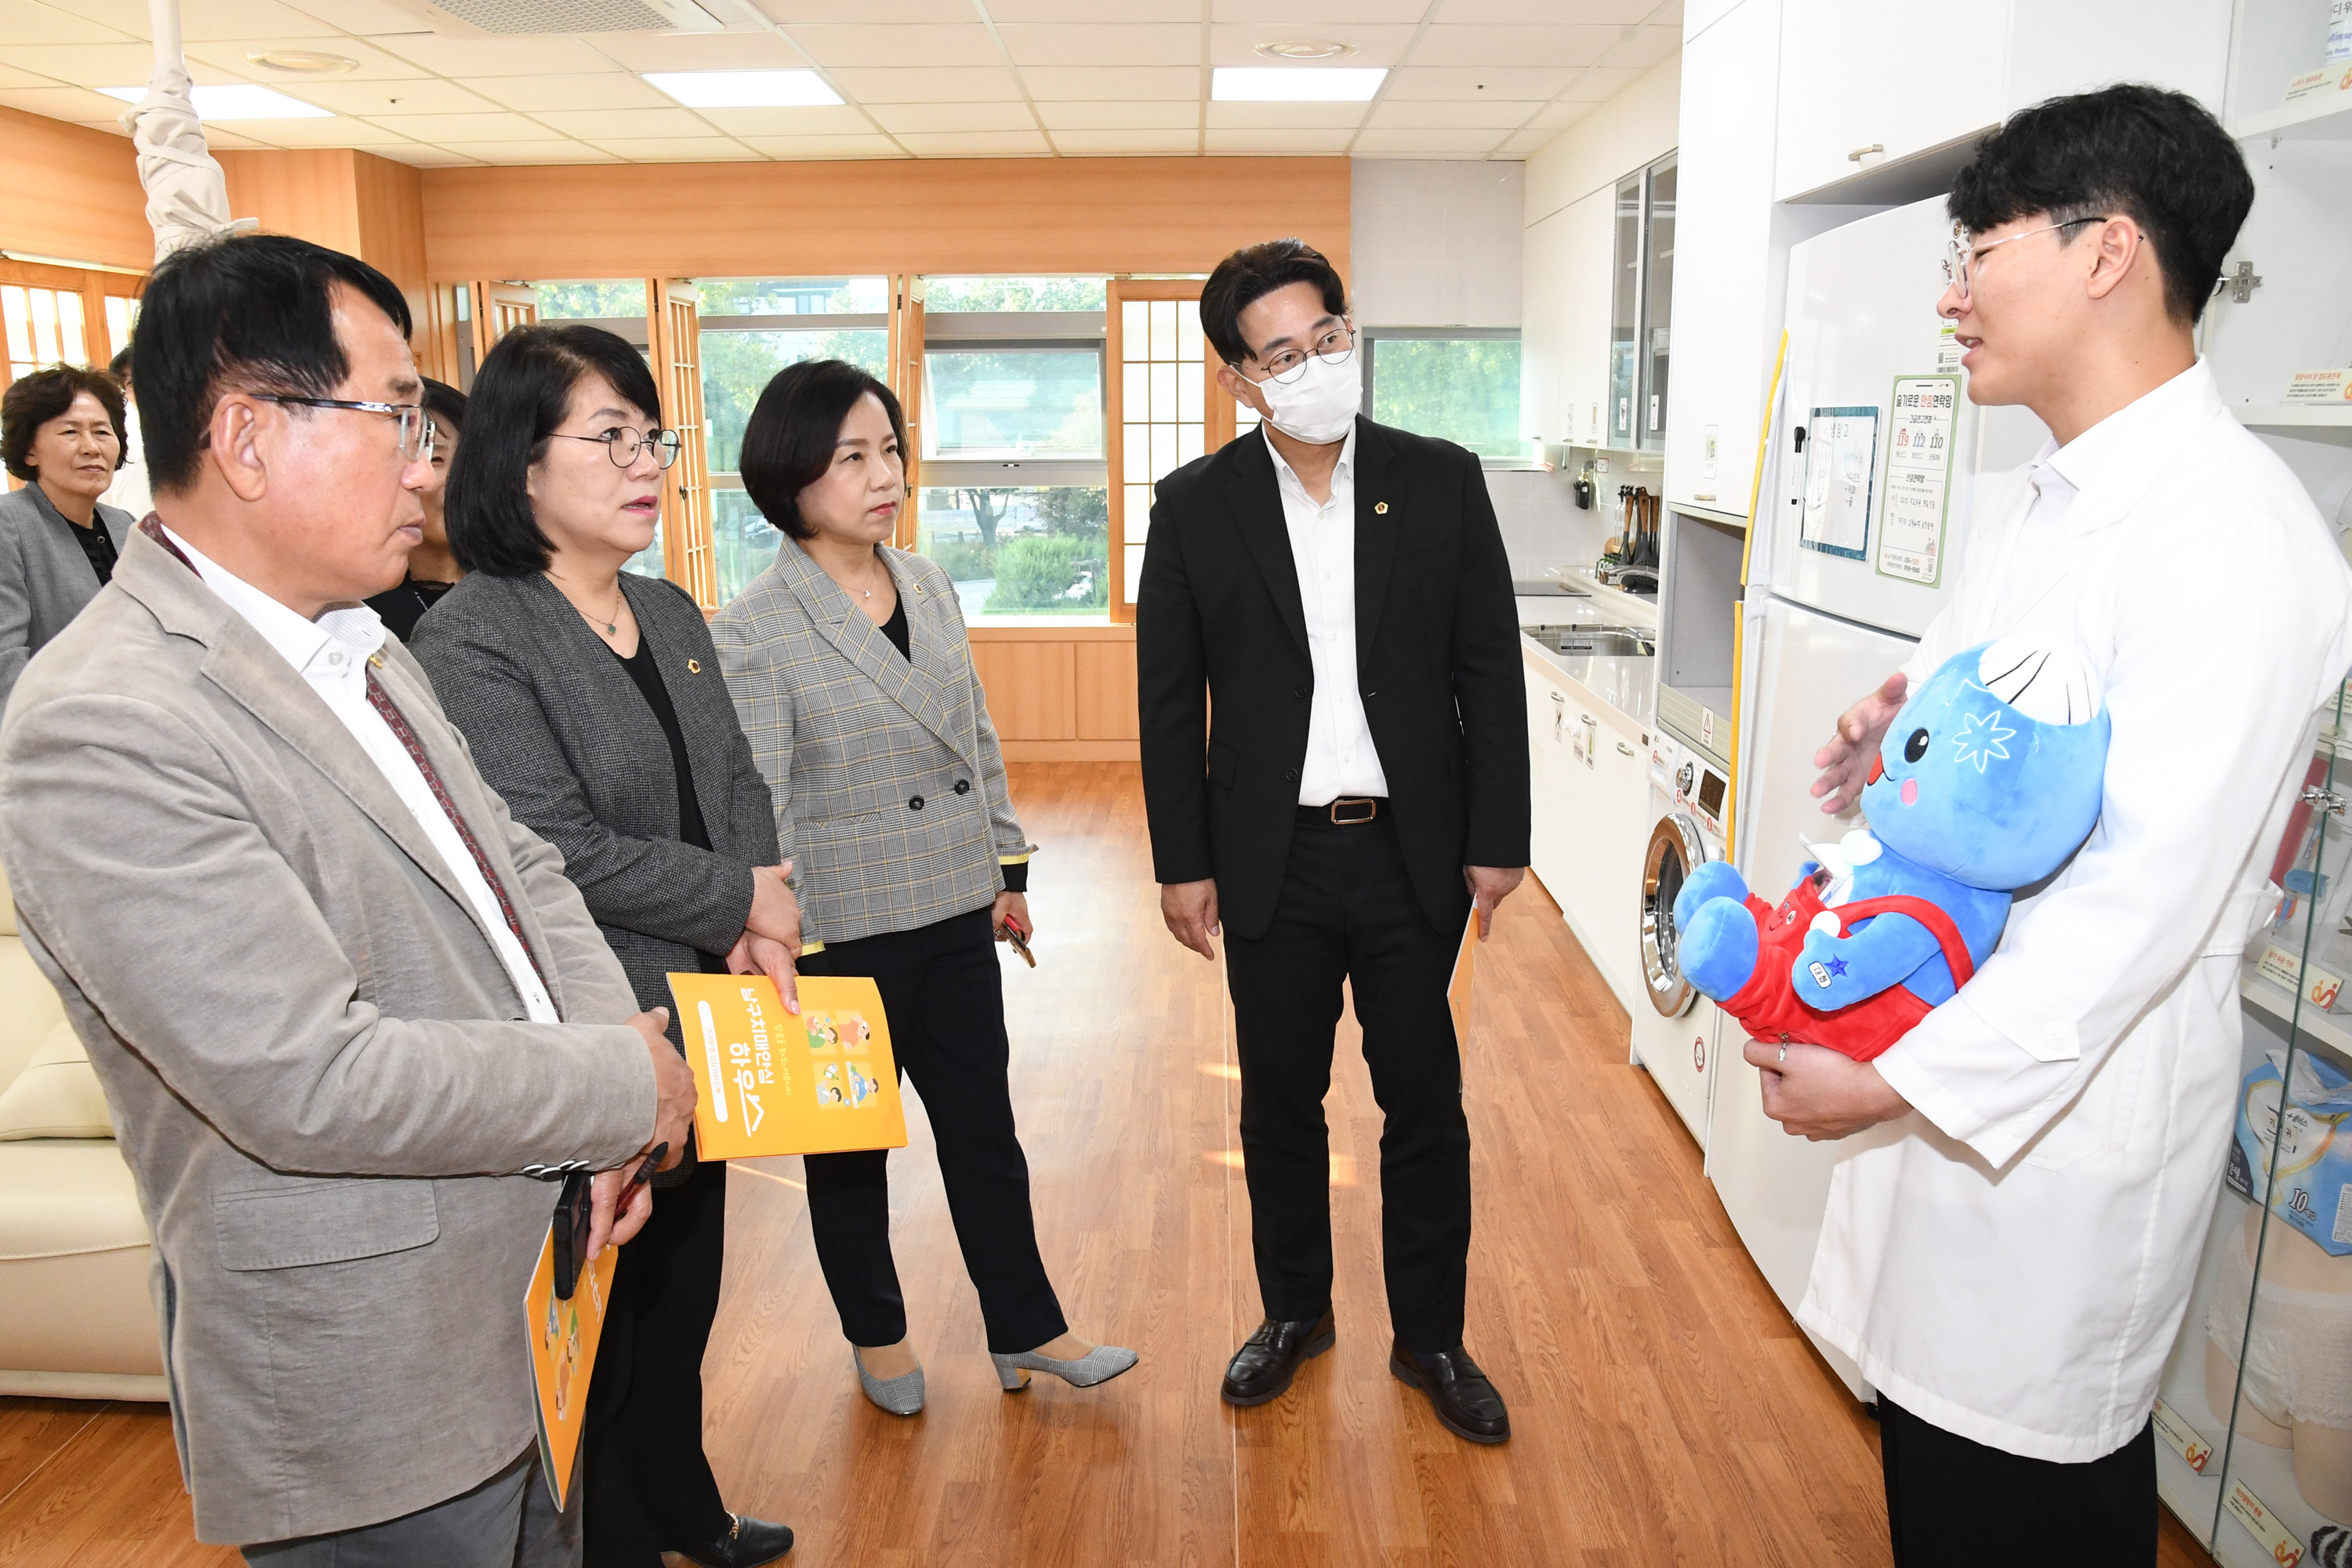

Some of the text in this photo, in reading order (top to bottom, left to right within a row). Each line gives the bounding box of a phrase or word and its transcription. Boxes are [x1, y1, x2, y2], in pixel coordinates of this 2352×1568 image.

[1896, 394, 1952, 408] 슬기로운 안심연락망
[1831, 423, 1849, 438] 냉장고
[1896, 434, 1944, 448] 119 112 110
[740, 988, 775, 1084] 남구치매안심
